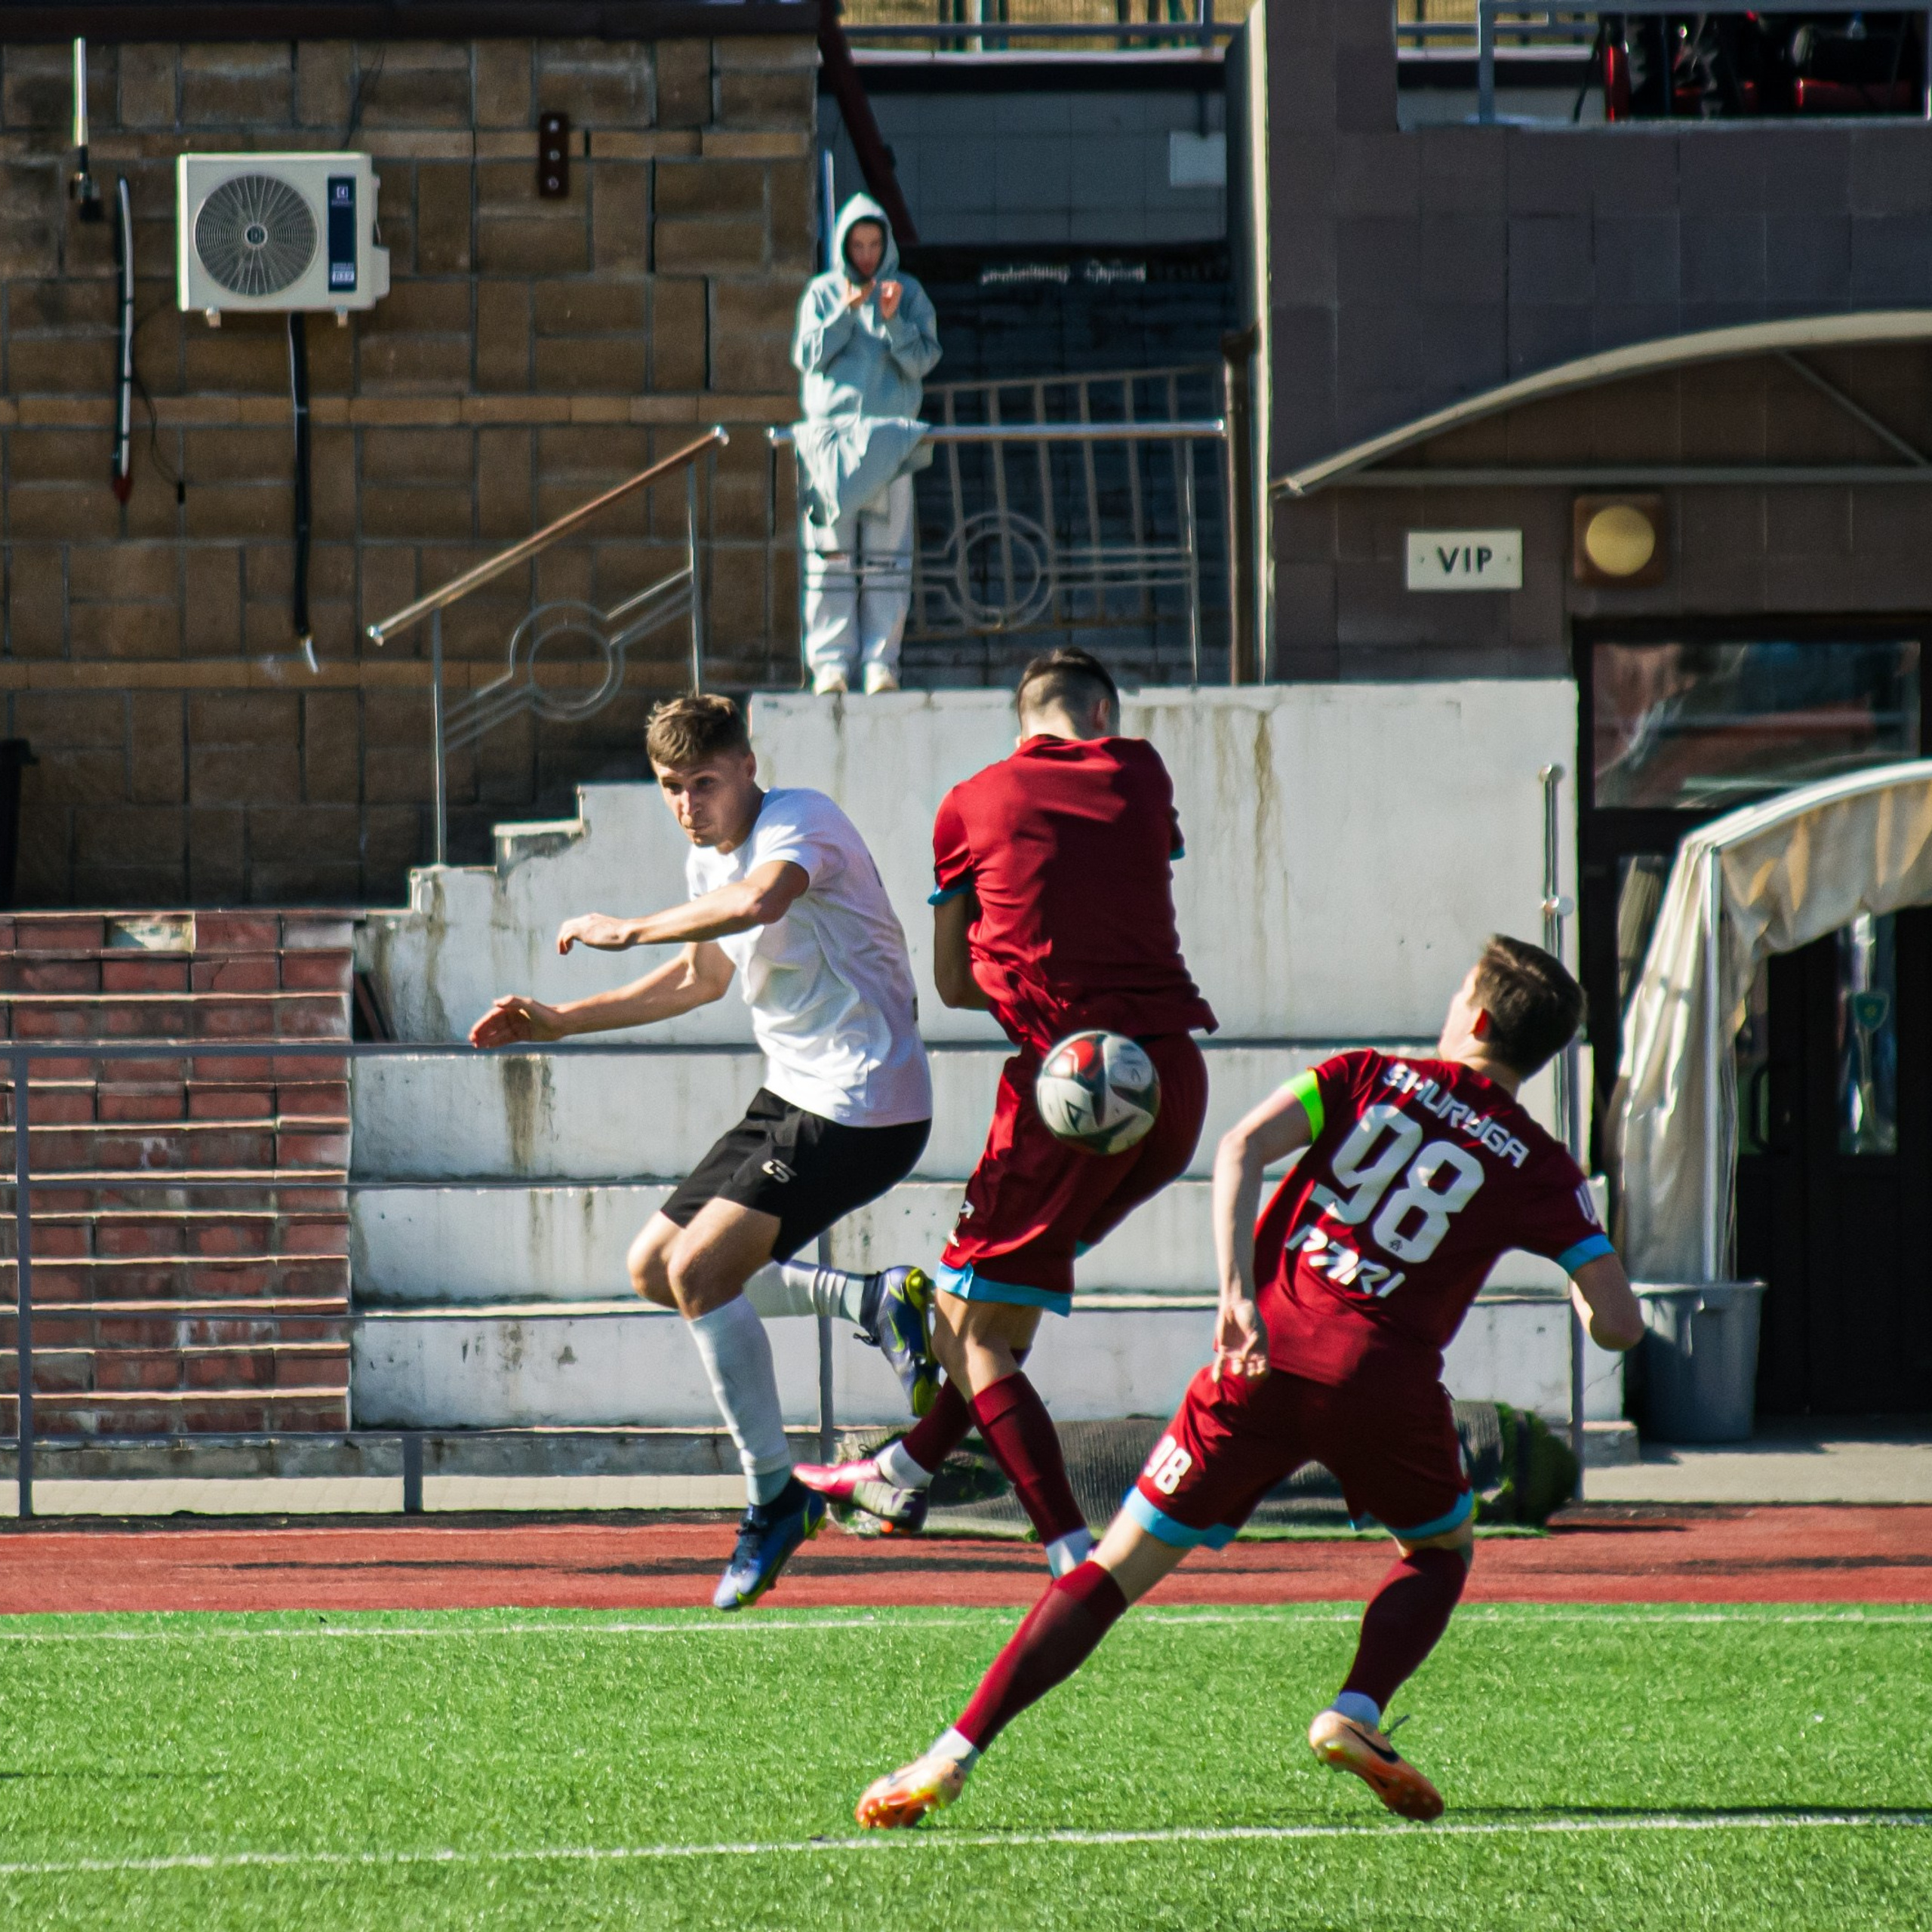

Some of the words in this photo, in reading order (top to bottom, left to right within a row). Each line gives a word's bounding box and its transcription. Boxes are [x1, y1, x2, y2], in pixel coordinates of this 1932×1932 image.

[1437, 545, 1493, 574] VIP
[1383, 1063, 1530, 1169] SHURYGA
[1309, 1104, 1485, 1264] 98
[1143, 1435, 1192, 1495] 98
